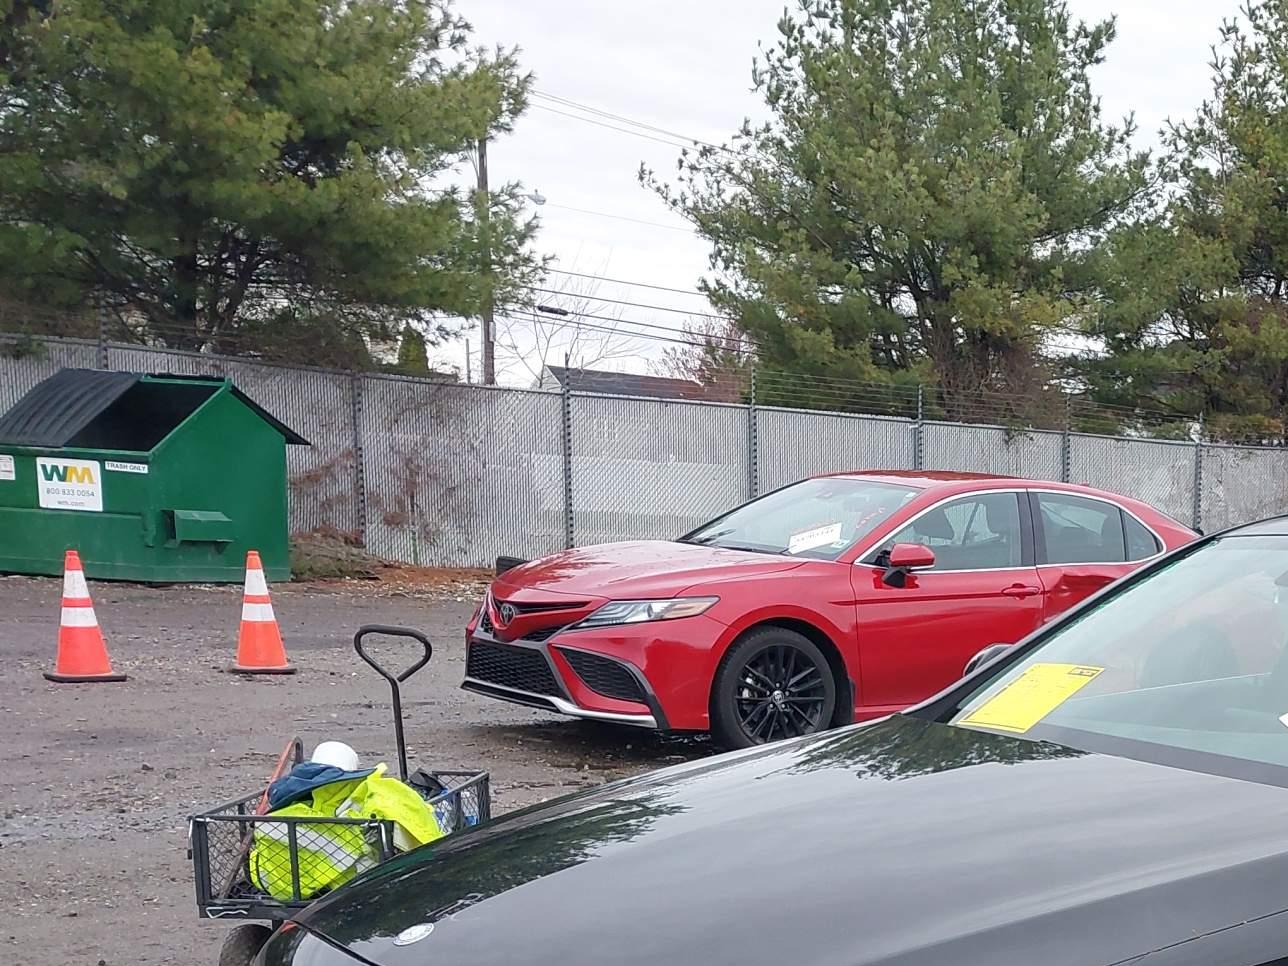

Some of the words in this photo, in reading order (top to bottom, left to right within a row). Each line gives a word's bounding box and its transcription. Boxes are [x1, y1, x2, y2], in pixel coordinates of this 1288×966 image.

[106, 462, 128, 470] TRASH
[129, 464, 146, 472] ONLY
[40, 463, 95, 484] WM
[46, 487, 60, 495] 800
